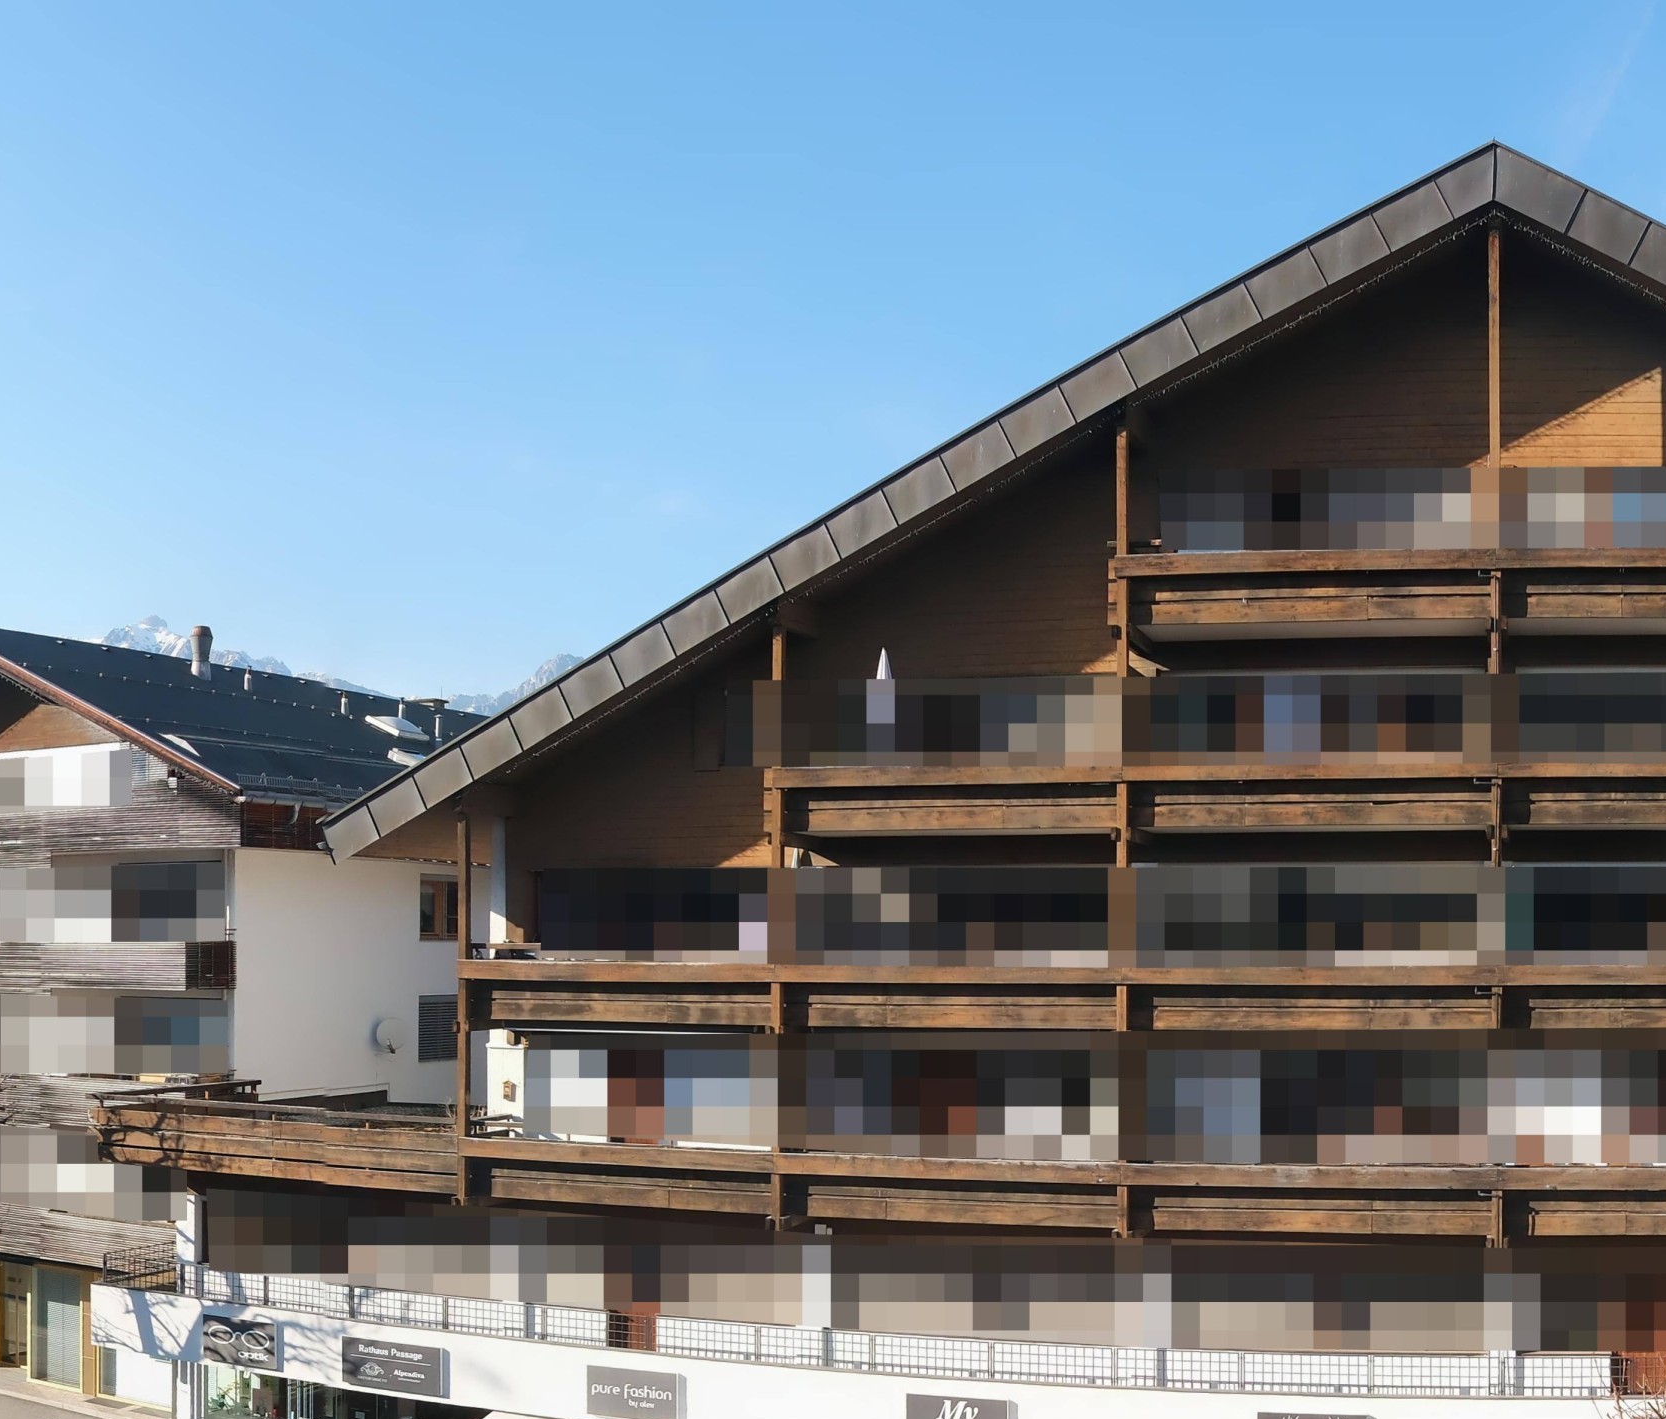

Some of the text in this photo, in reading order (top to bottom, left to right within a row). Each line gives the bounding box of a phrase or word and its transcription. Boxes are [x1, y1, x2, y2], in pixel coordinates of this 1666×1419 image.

[237, 1350, 269, 1363] optik
[358, 1344, 423, 1361] Rathaus Passage
[591, 1383, 672, 1401] pure fashion
